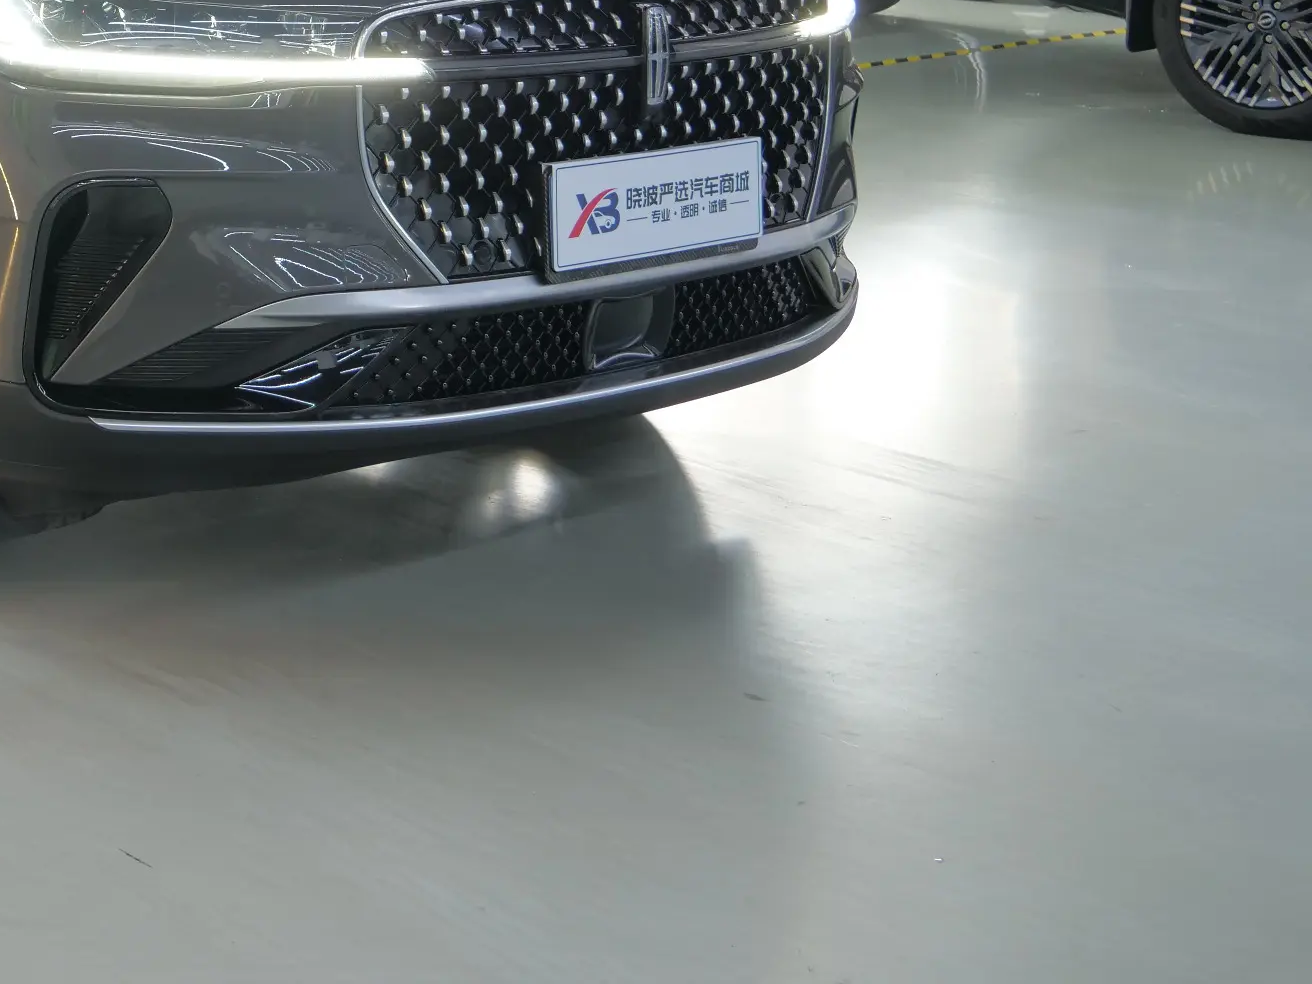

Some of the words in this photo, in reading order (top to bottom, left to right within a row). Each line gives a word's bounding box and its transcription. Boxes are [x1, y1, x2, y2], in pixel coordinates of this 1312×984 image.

[568, 187, 621, 239] XB
[625, 170, 751, 211] 晓波严选汽车商城
